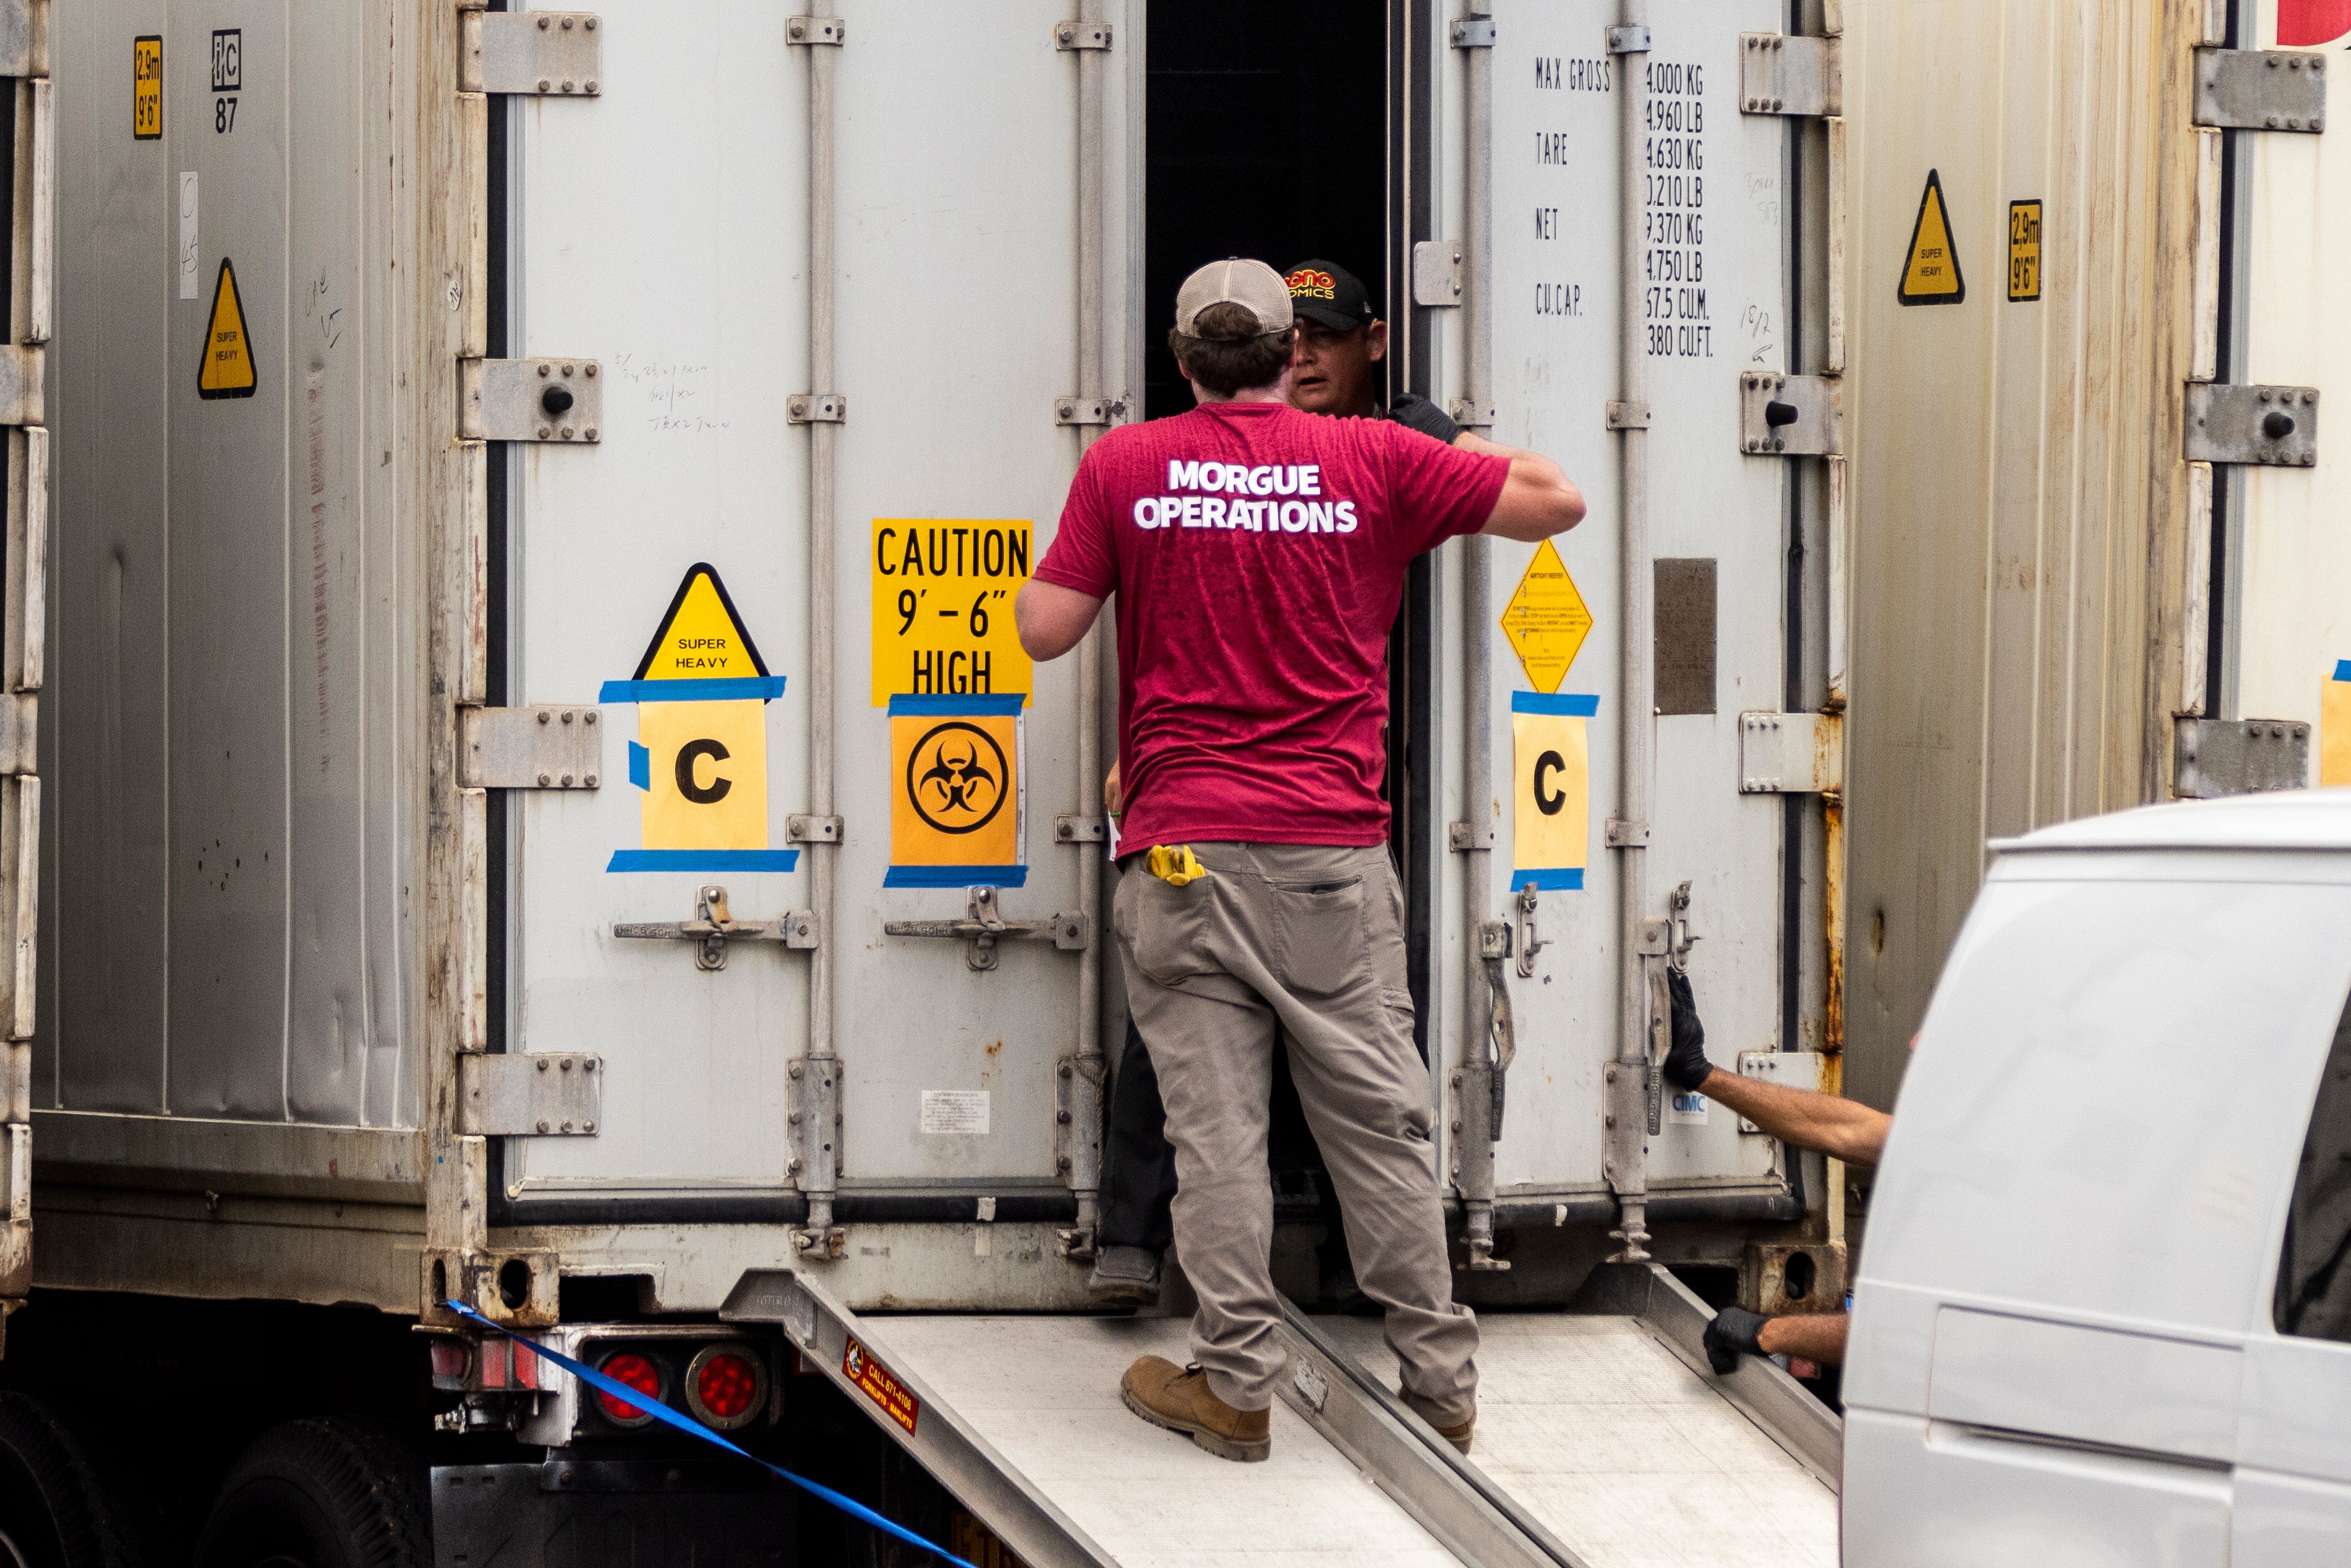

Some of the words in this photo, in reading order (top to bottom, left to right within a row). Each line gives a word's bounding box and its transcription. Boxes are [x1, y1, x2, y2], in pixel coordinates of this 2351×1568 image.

[137, 49, 160, 86] 2,9m
[1536, 57, 1561, 90] MAX
[1570, 59, 1610, 92] GROSS
[1687, 64, 1703, 96] KG
[215, 97, 238, 134] 87
[1687, 101, 1703, 133] LB
[1536, 132, 1568, 165] TARE
[1687, 139, 1703, 170] KG
[1687, 176, 1703, 208] LB
[1536, 208, 1558, 240] NET
[1687, 213, 1703, 245] KG
[2012, 211, 2039, 250] 2,9m
[1687, 250, 1703, 282] LB
[1921, 248, 1943, 258] SUPER
[1921, 266, 1942, 276] HEAVY
[1536, 283, 1582, 316] CU.CAP.
[1679, 288, 1709, 320] CU.M.
[216, 331, 237, 343] SUPER
[1679, 326, 1713, 357] CU.FT.
[216, 350, 238, 361] HEAVY
[1169, 459, 1321, 496] MORGUE
[1134, 496, 1358, 533] OPERATIONS
[877, 527, 1028, 577] CAUTION
[678, 639, 726, 649] SUPER
[676, 657, 728, 668] HEAVY
[913, 650, 991, 694] HIGH
[675, 739, 732, 804] C
[1534, 750, 1566, 816] C
[1672, 1094, 1705, 1112] CIMC
[862, 1378, 887, 1405] FORKLIFTS
[890, 1402, 913, 1429] MANLIFTS
[869, 1365, 885, 1388] CALL
[885, 1379, 911, 1411] 871-4108
